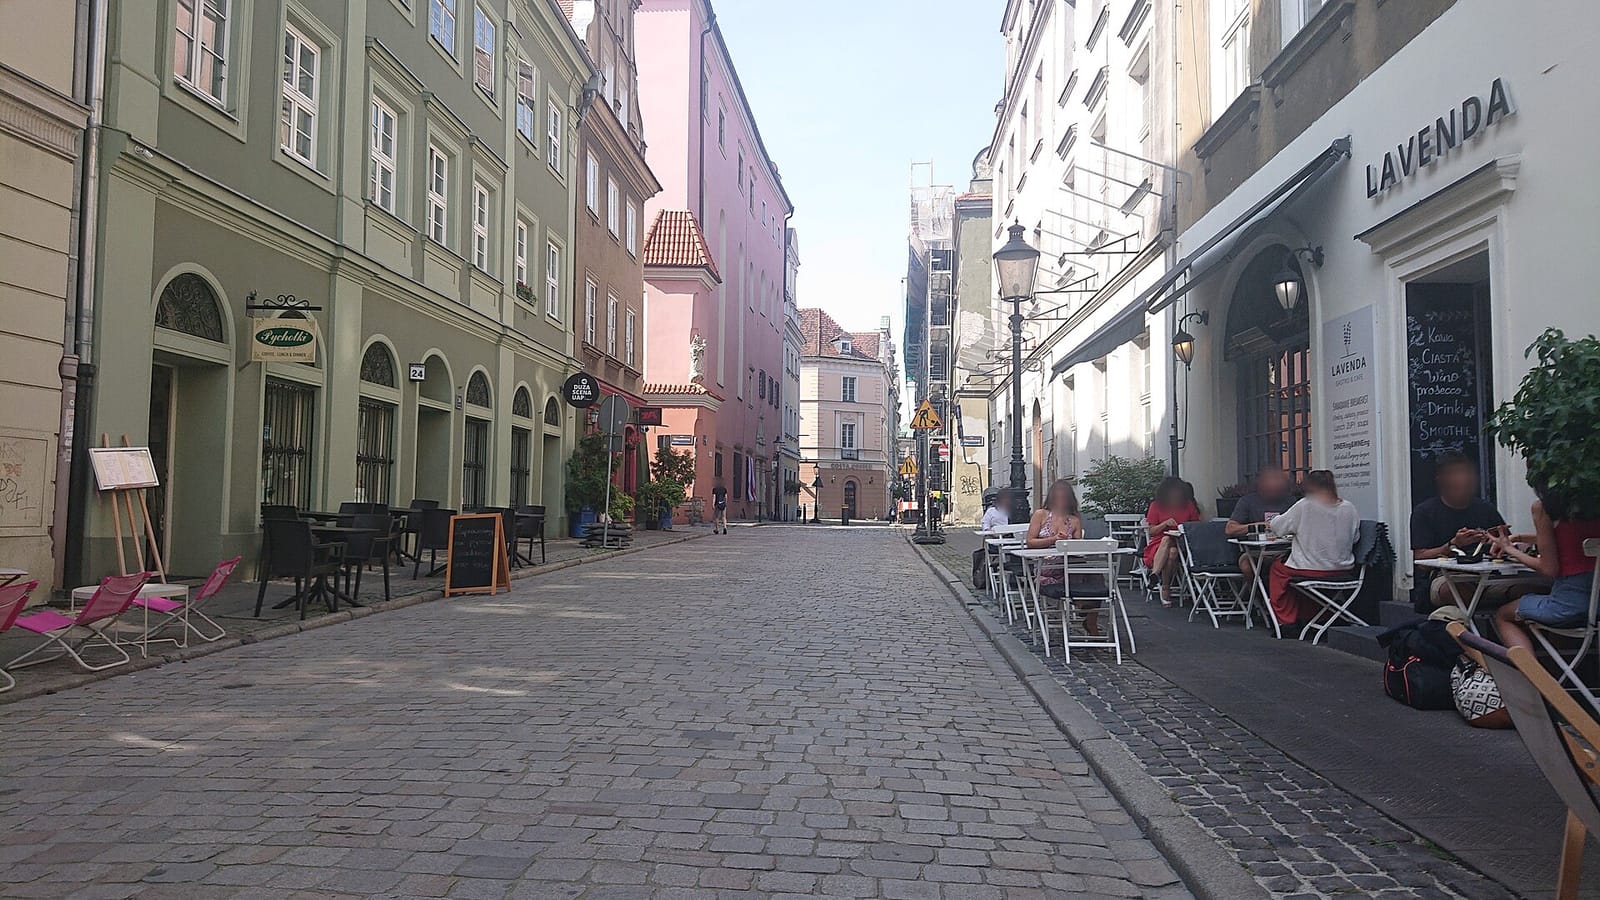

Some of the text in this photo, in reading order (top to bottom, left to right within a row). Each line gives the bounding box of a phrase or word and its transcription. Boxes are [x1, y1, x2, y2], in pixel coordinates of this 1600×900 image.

[1366, 77, 1510, 199] LAVENDA
[411, 369, 423, 378] 24
[1331, 356, 1367, 377] LAVENDA
[1424, 369, 1459, 383] Wino
[1416, 385, 1462, 402] prosecco
[1428, 401, 1464, 416] Drinki
